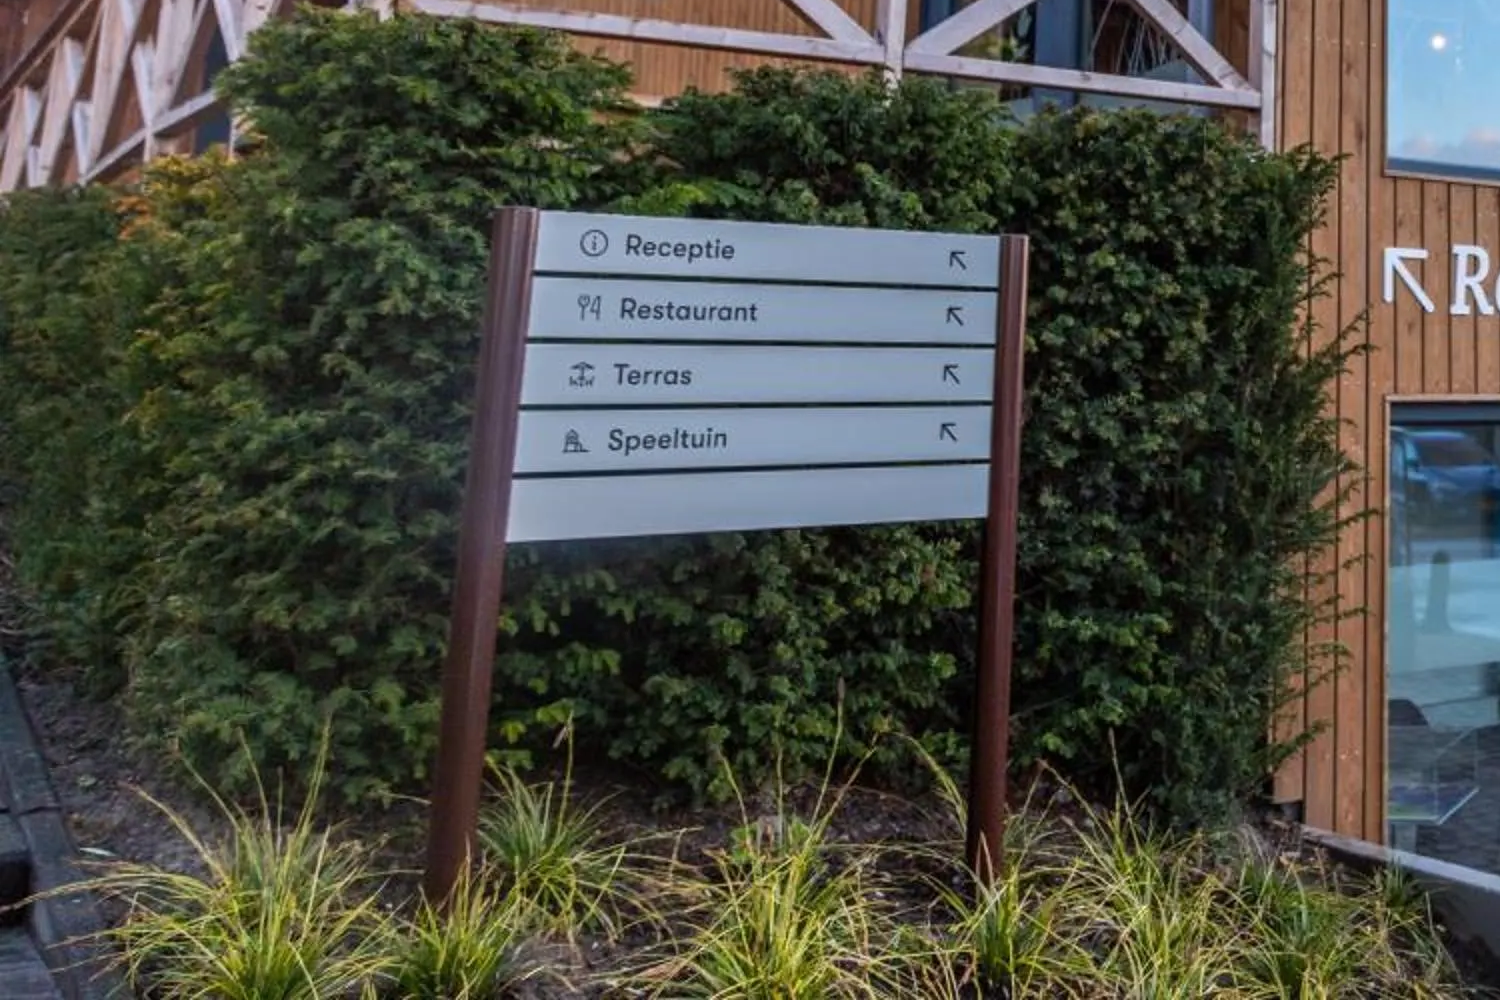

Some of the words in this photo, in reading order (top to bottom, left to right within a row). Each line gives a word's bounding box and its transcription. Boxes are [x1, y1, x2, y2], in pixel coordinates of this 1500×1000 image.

[625, 234, 735, 263] Receptie
[619, 297, 758, 323] Restaurant
[613, 362, 692, 387] Terras
[607, 427, 728, 456] Speeltuin
